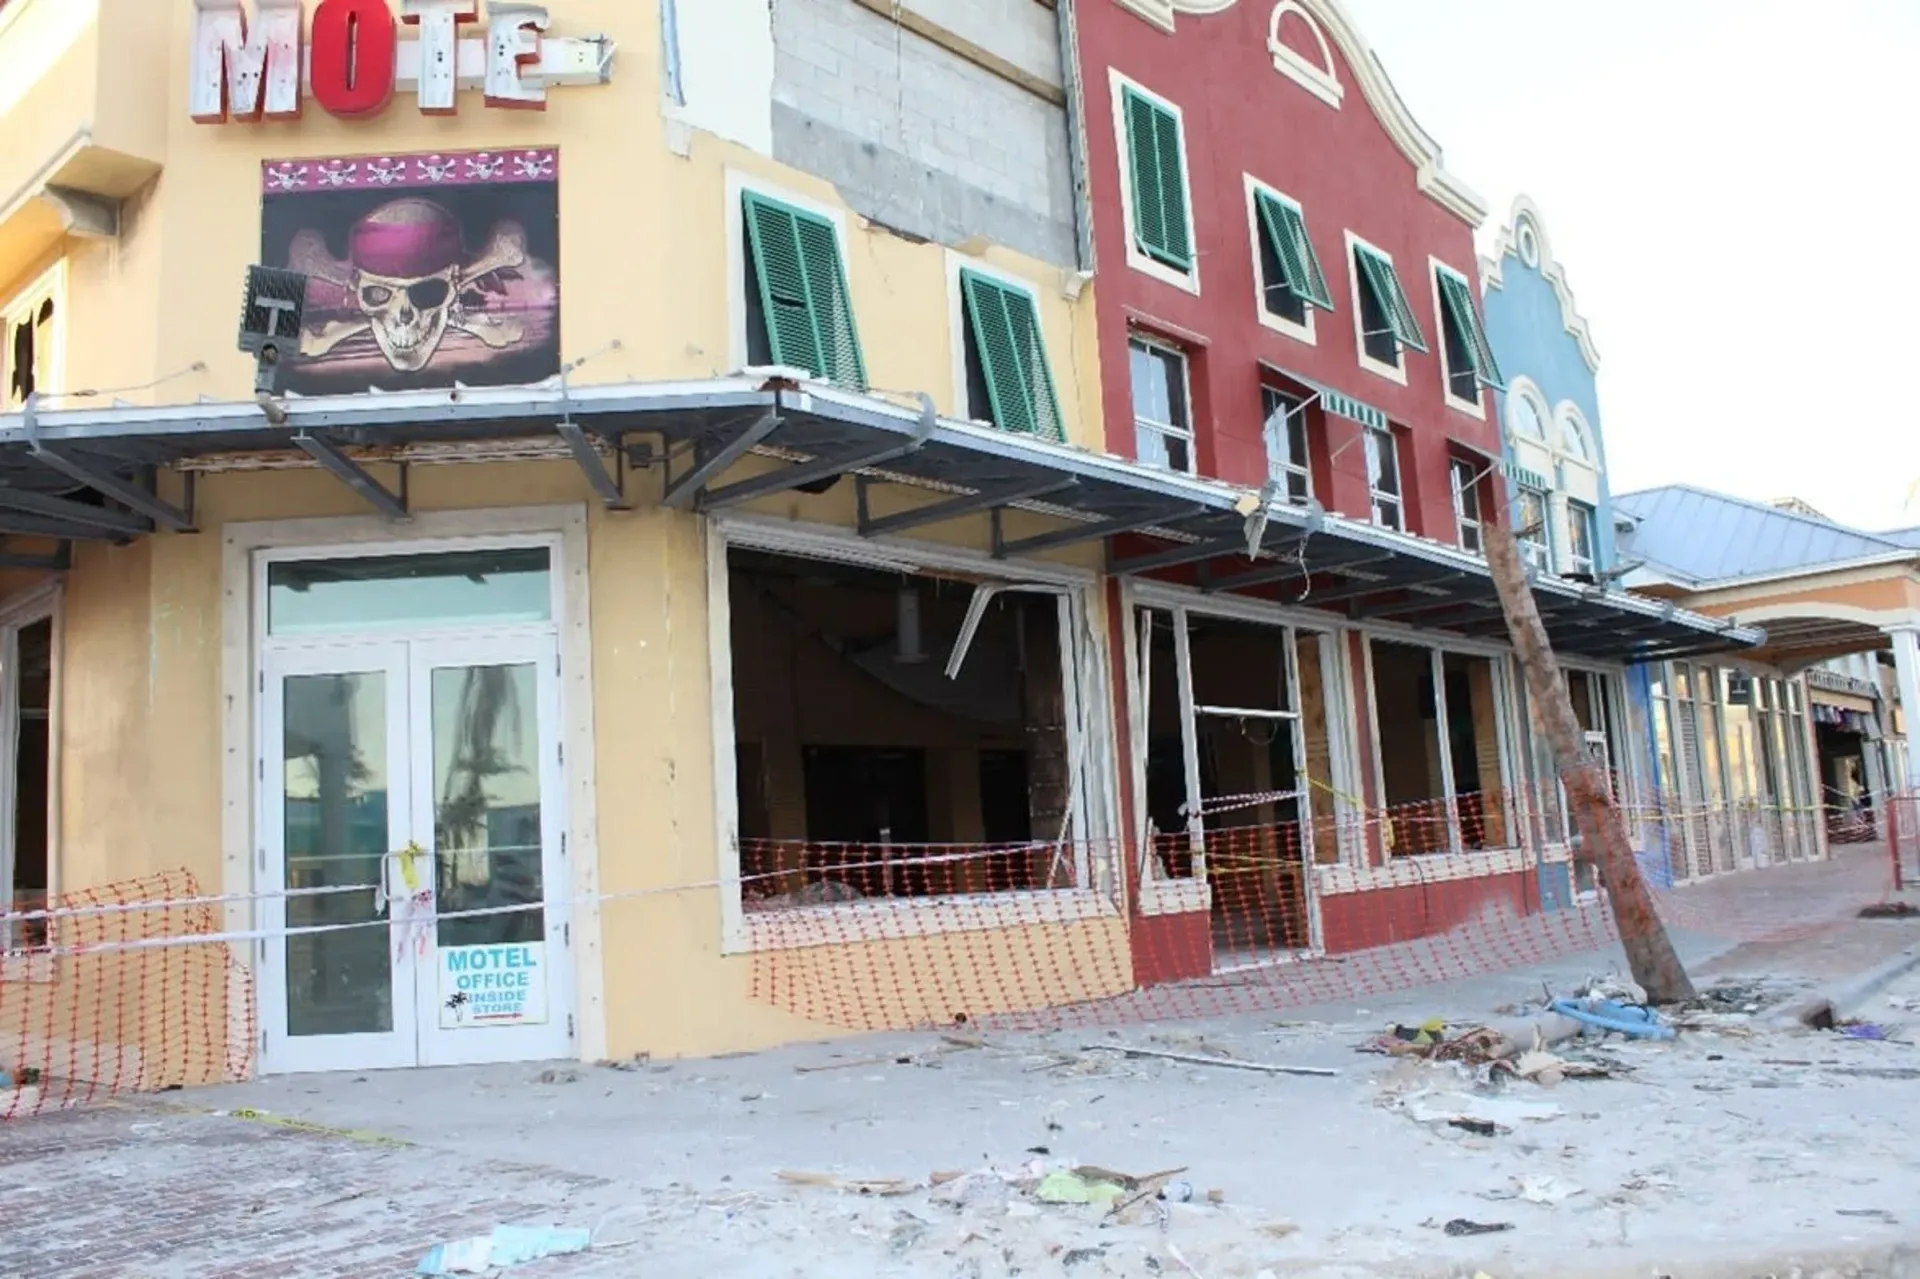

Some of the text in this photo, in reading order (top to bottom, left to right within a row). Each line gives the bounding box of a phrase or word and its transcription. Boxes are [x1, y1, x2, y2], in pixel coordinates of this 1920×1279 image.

[448, 947, 537, 972] MOTEL
[457, 972, 529, 990] OFFICE
[468, 990, 526, 1003] INSIDE
[472, 1003, 522, 1014] STORE
